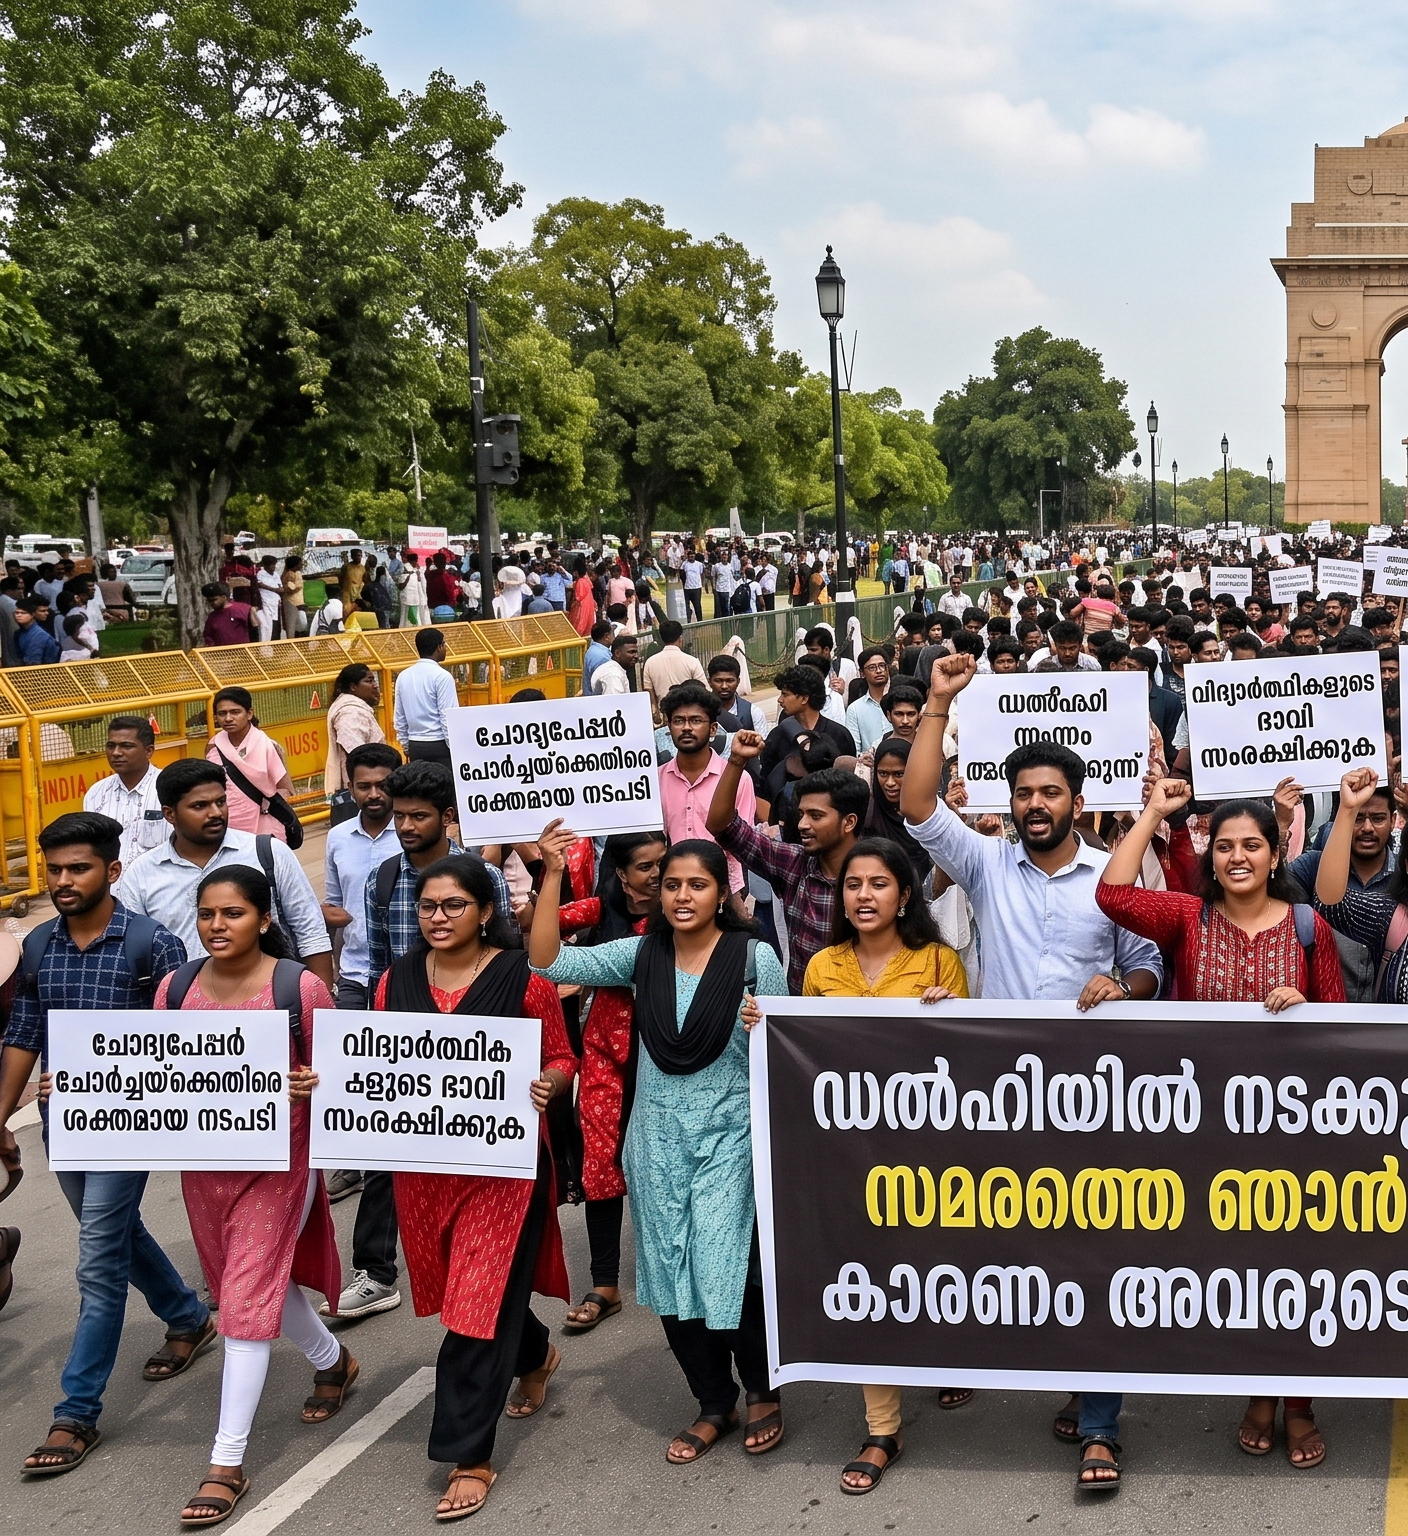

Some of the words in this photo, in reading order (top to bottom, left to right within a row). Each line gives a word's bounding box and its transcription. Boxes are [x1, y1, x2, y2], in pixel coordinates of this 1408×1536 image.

[1192, 672, 1375, 706] വിദ്യാർത്ഥികളുടെ
[475, 709, 627, 750] ചോദ്യപേപ്പർ
[1257, 702, 1314, 732] ഭാവി
[1201, 734, 1376, 768] സംരക്ഷിക്കുക
[42, 773, 87, 805] INDIA
[467, 786, 575, 814] ശക്തമായ
[582, 774, 652, 804] നടപടി
[92, 1026, 245, 1062] ചോദ്യപേപ്പർ
[55, 1063, 282, 1101] ചോർച്ചയ്ക്കെതിരെ
[441, 1069, 506, 1101] ഭാവി
[813, 1053, 1202, 1134] ഡൽഹിയിൽ
[63, 1107, 189, 1132] ശക്തമായ
[197, 1101, 277, 1132] നടപടി
[323, 1104, 525, 1146] സംരക്ഷിക്കുക
[865, 1164, 1186, 1231] സമരത്തെ
[1208, 1154, 1407, 1234] ഞാൻ
[822, 1261, 1086, 1328] കാരണം
